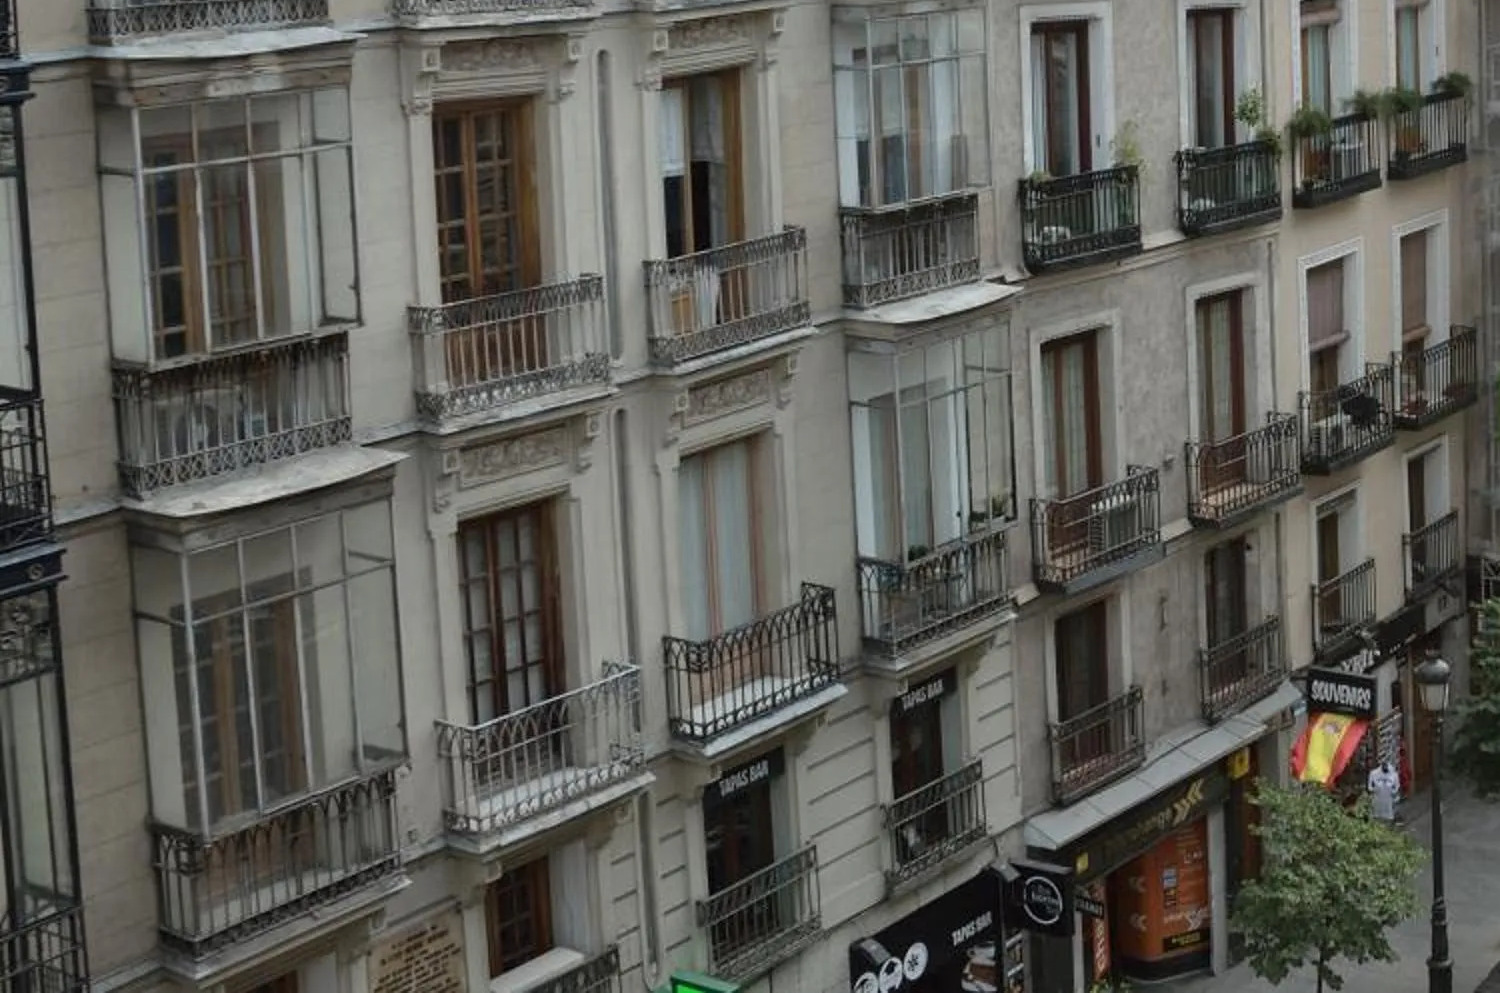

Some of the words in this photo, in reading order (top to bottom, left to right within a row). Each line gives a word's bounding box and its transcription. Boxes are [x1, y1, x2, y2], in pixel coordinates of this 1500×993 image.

[902, 686, 927, 711] TAPAS
[928, 678, 944, 699] BAR
[720, 769, 749, 797] TAPAS
[750, 760, 769, 783] BAR
[951, 921, 976, 946] TAPAS
